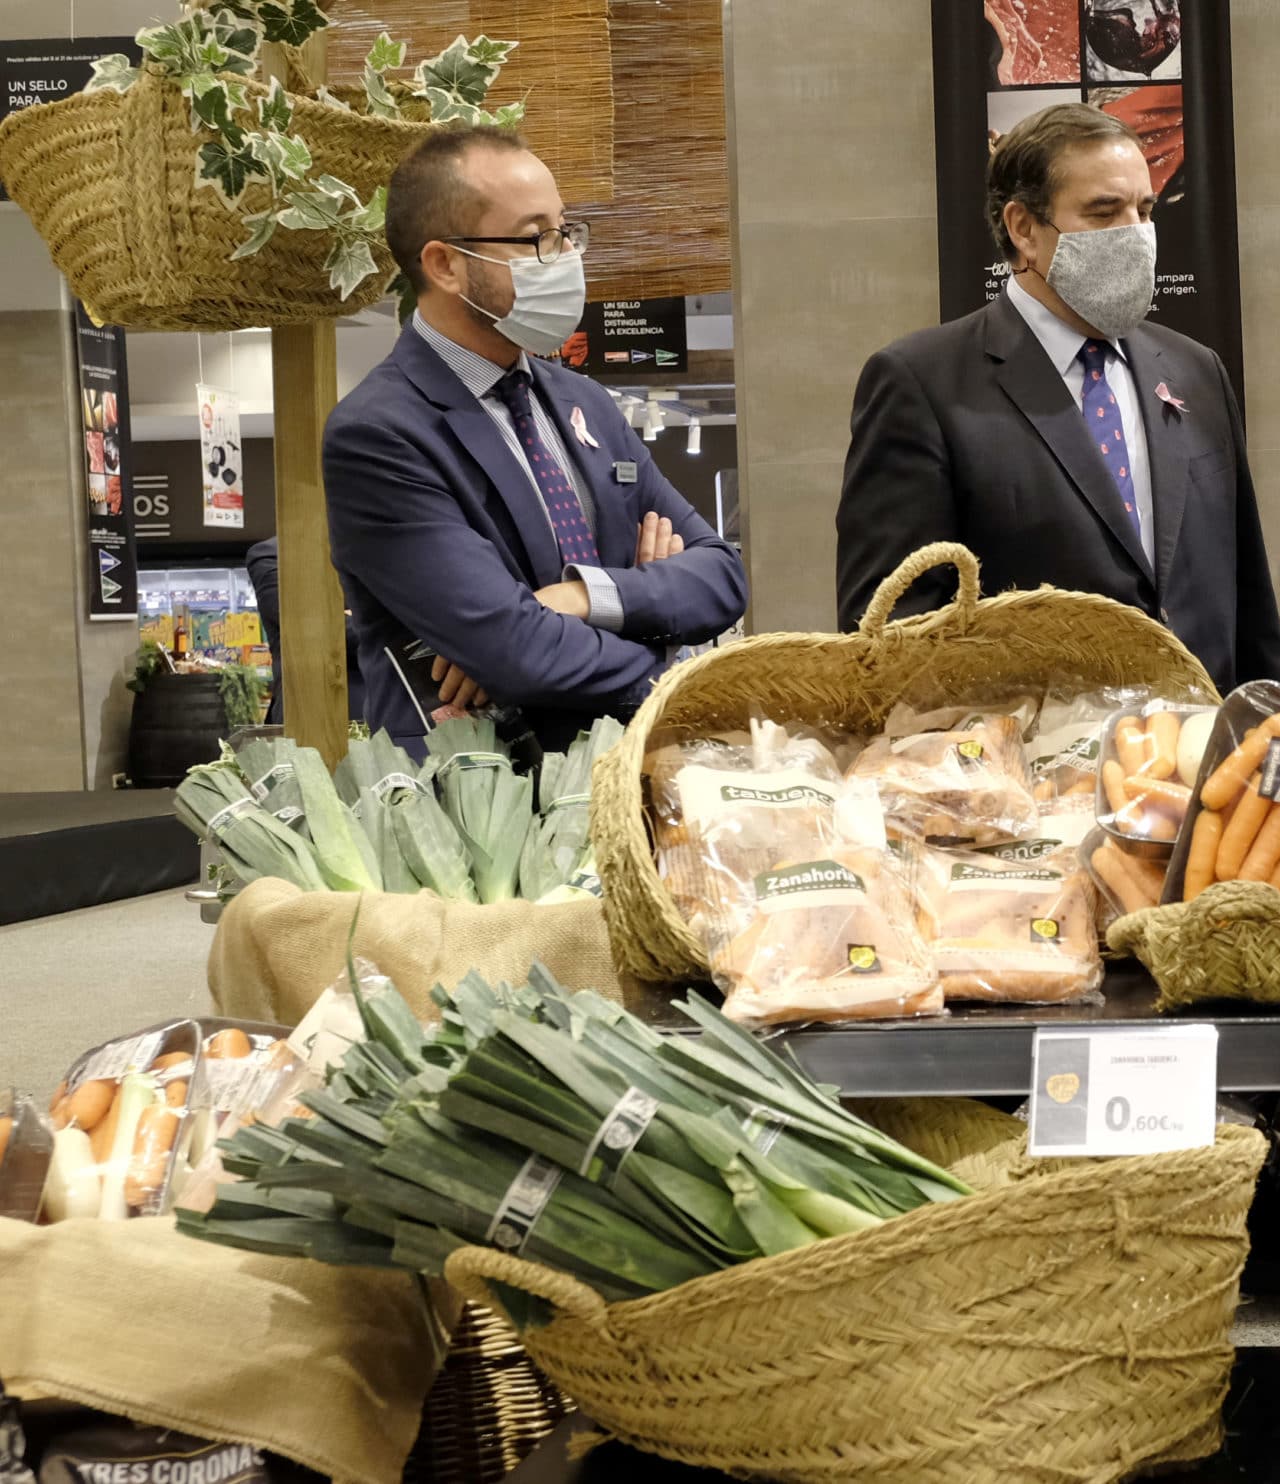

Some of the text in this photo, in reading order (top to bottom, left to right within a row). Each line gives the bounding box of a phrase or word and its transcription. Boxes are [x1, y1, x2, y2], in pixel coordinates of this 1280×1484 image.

[8, 79, 68, 92] UN SELLO
[9, 95, 42, 106] PARA
[985, 279, 998, 288] de
[1156, 274, 1194, 283] ampara
[1162, 285, 1198, 295] origen.
[603, 301, 640, 310] UN SELLO
[604, 310, 625, 318] PARA
[604, 318, 647, 327] DISTINGUIR
[604, 326, 664, 336] LA EXCELENCIA
[134, 495, 169, 516] OS
[766, 867, 857, 890] Zanahoria
[77, 1462, 148, 1484] TRES
